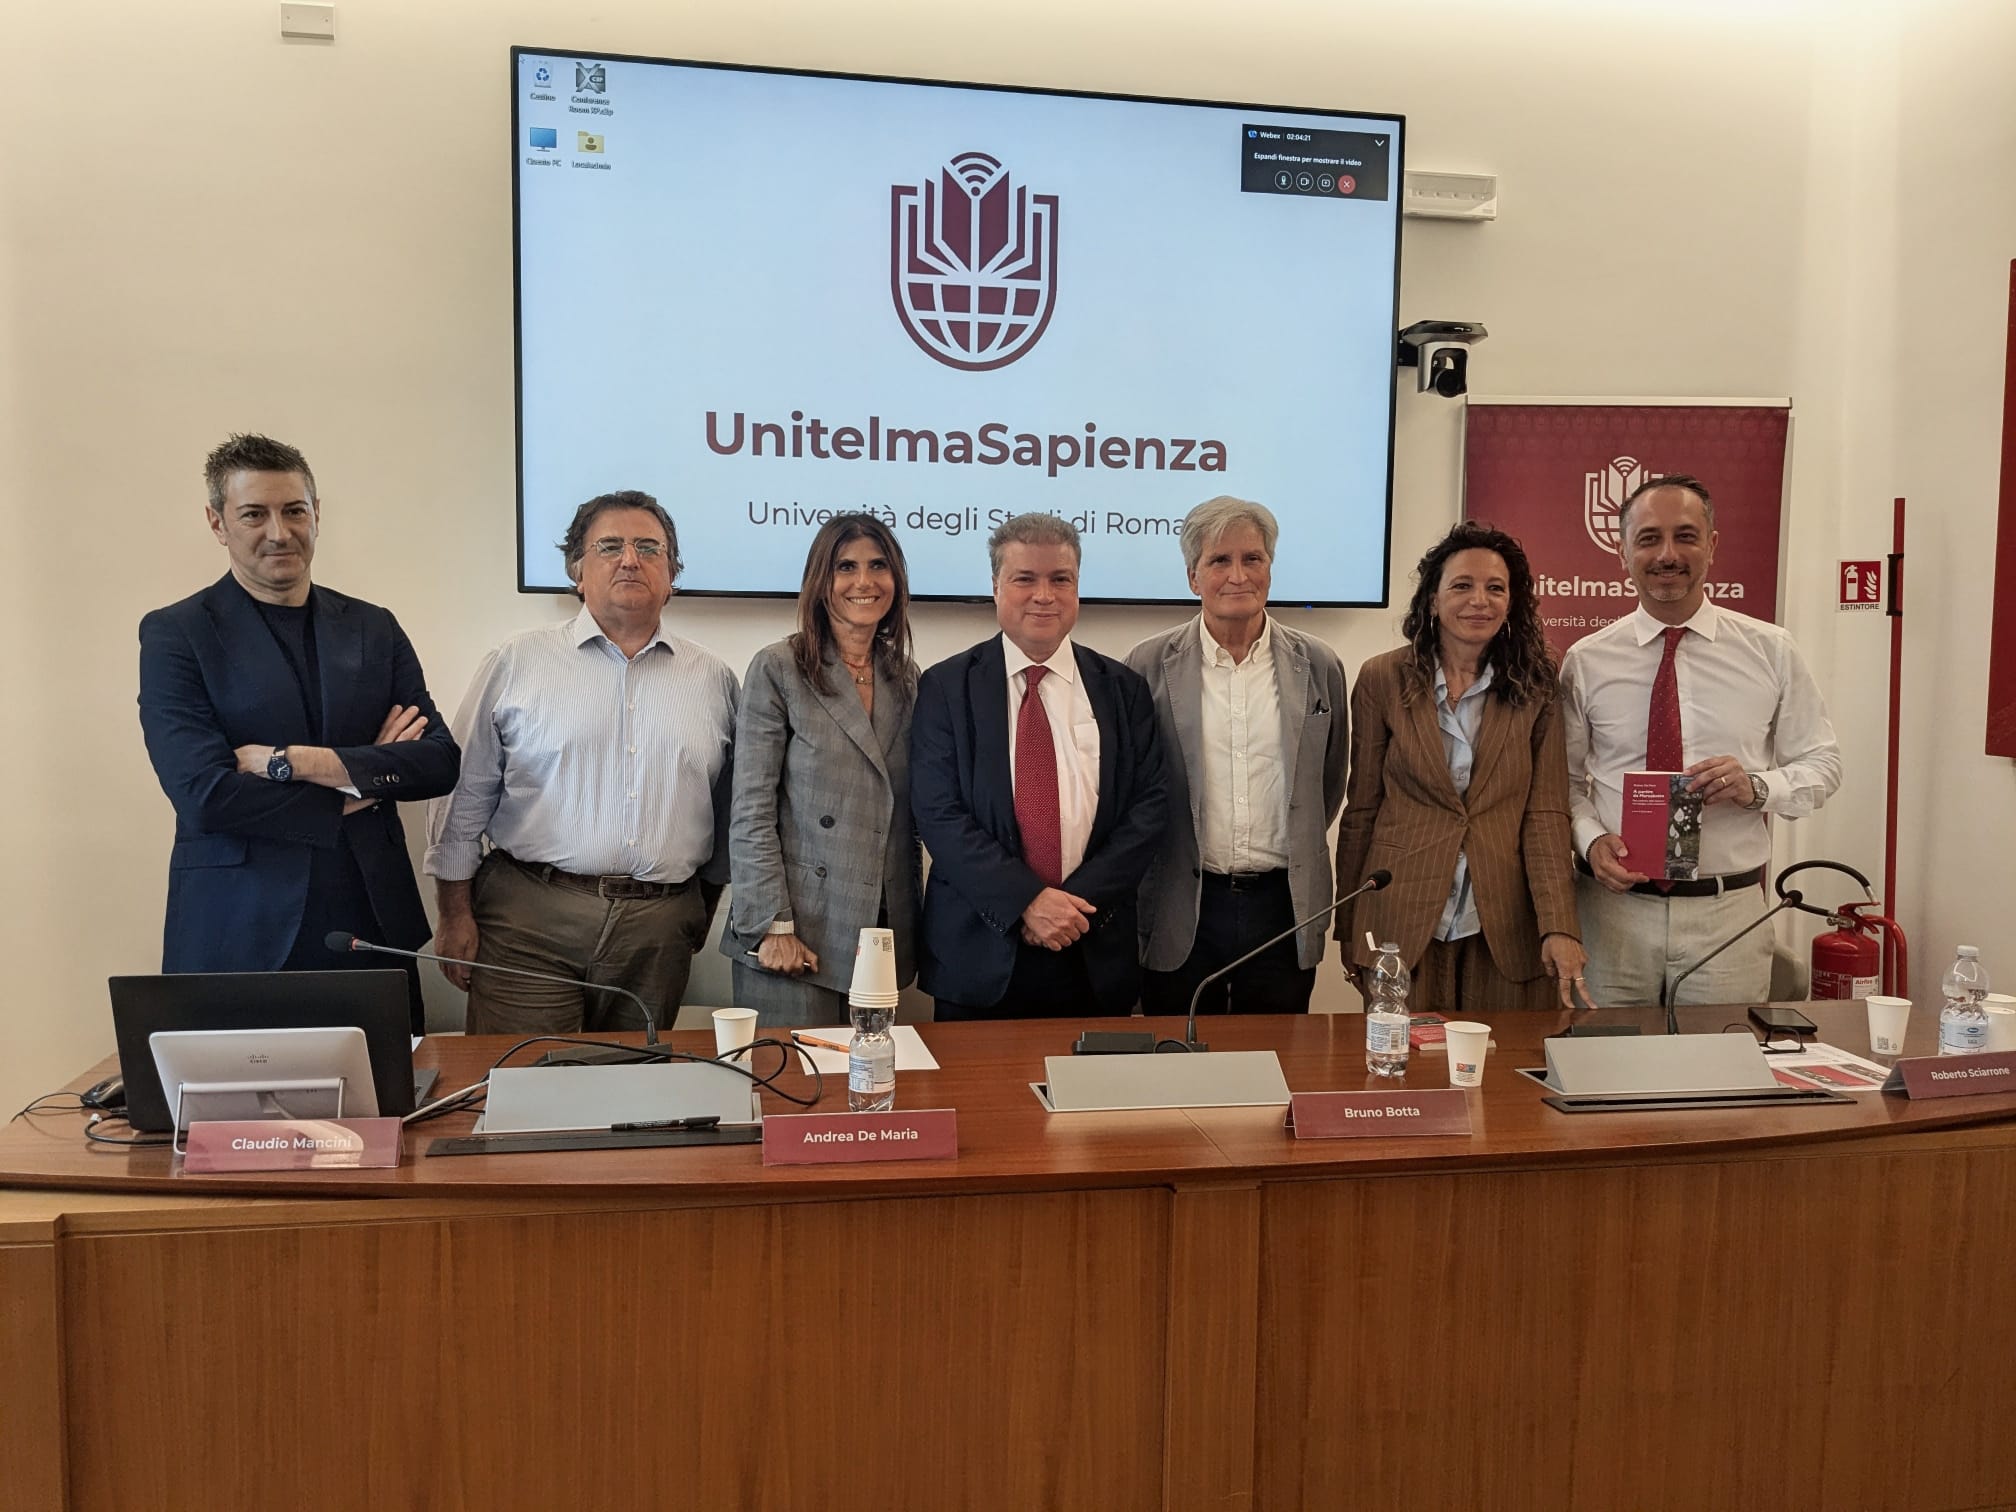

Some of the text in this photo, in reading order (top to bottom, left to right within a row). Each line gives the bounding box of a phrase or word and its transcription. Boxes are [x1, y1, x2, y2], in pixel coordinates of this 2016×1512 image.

[1286, 133, 1311, 141] 02:04:21
[1254, 153, 1277, 161] Espandi
[1278, 154, 1301, 162] finestra
[706, 410, 1227, 477] UnitelmaSapienza
[906, 506, 978, 536] degli
[1071, 510, 1096, 534] di
[1840, 603, 1880, 611] ESTINTORE
[1542, 615, 1586, 628] versità
[1930, 1067, 2011, 1080] Roberto Sciarrone
[1344, 1106, 1421, 1118] Bruno Botta
[803, 1128, 919, 1143] Andrea De Maria
[231, 1135, 352, 1150] Claudio Mancini
